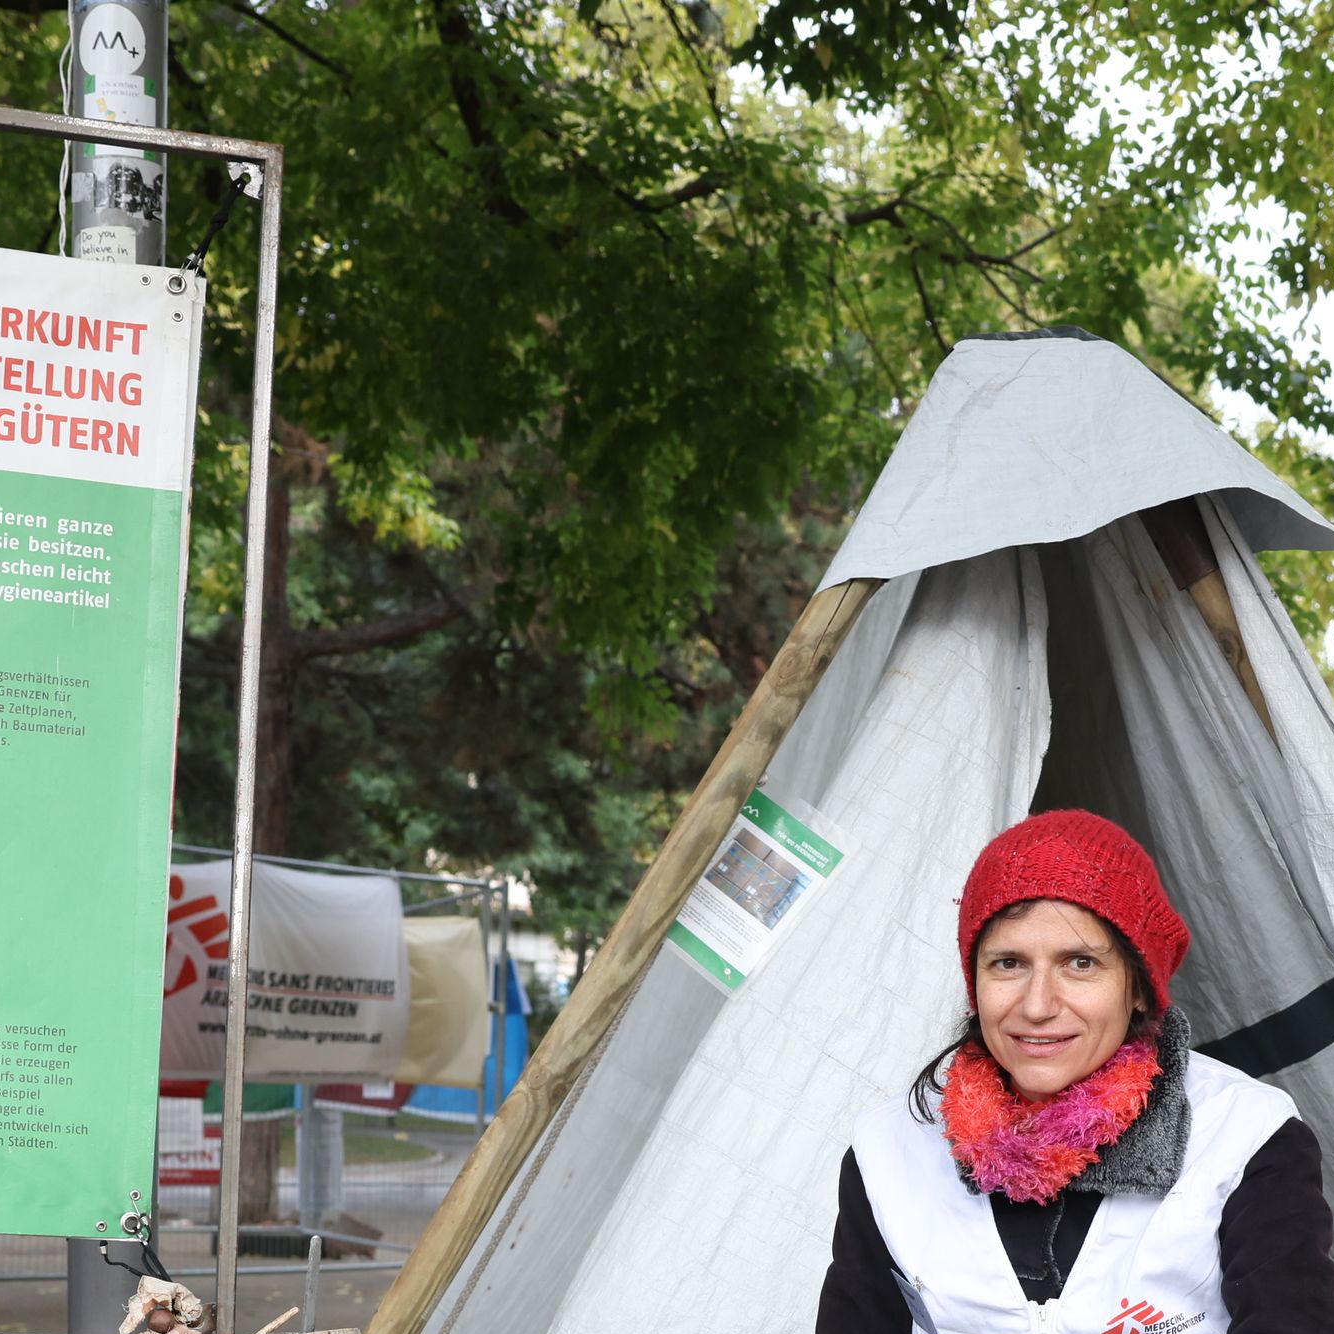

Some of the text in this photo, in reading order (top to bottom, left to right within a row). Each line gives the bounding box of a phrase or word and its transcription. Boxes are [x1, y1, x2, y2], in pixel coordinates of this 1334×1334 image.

[98, 231, 116, 244] you
[57, 518, 113, 537] ganze
[28, 535, 111, 561] besitzen.
[60, 563, 111, 585] leicht
[53, 690, 72, 703] für
[8, 702, 76, 722] Zeltplanen,
[12, 719, 85, 737] Baumaterial
[269, 972, 310, 990] SANS
[288, 998, 359, 1017] GRENZEN
[5, 1024, 66, 1037] versuchen
[23, 1040, 53, 1053] Form
[57, 1042, 79, 1054] der
[15, 1057, 70, 1071] erzeugen
[18, 1074, 40, 1084] aus
[43, 1073, 73, 1086] allen
[25, 1104, 45, 1117] die
[65, 1122, 89, 1136] sich
[8, 1135, 58, 1150] Städten.
[1144, 1313, 1185, 1332] MEDECINS
